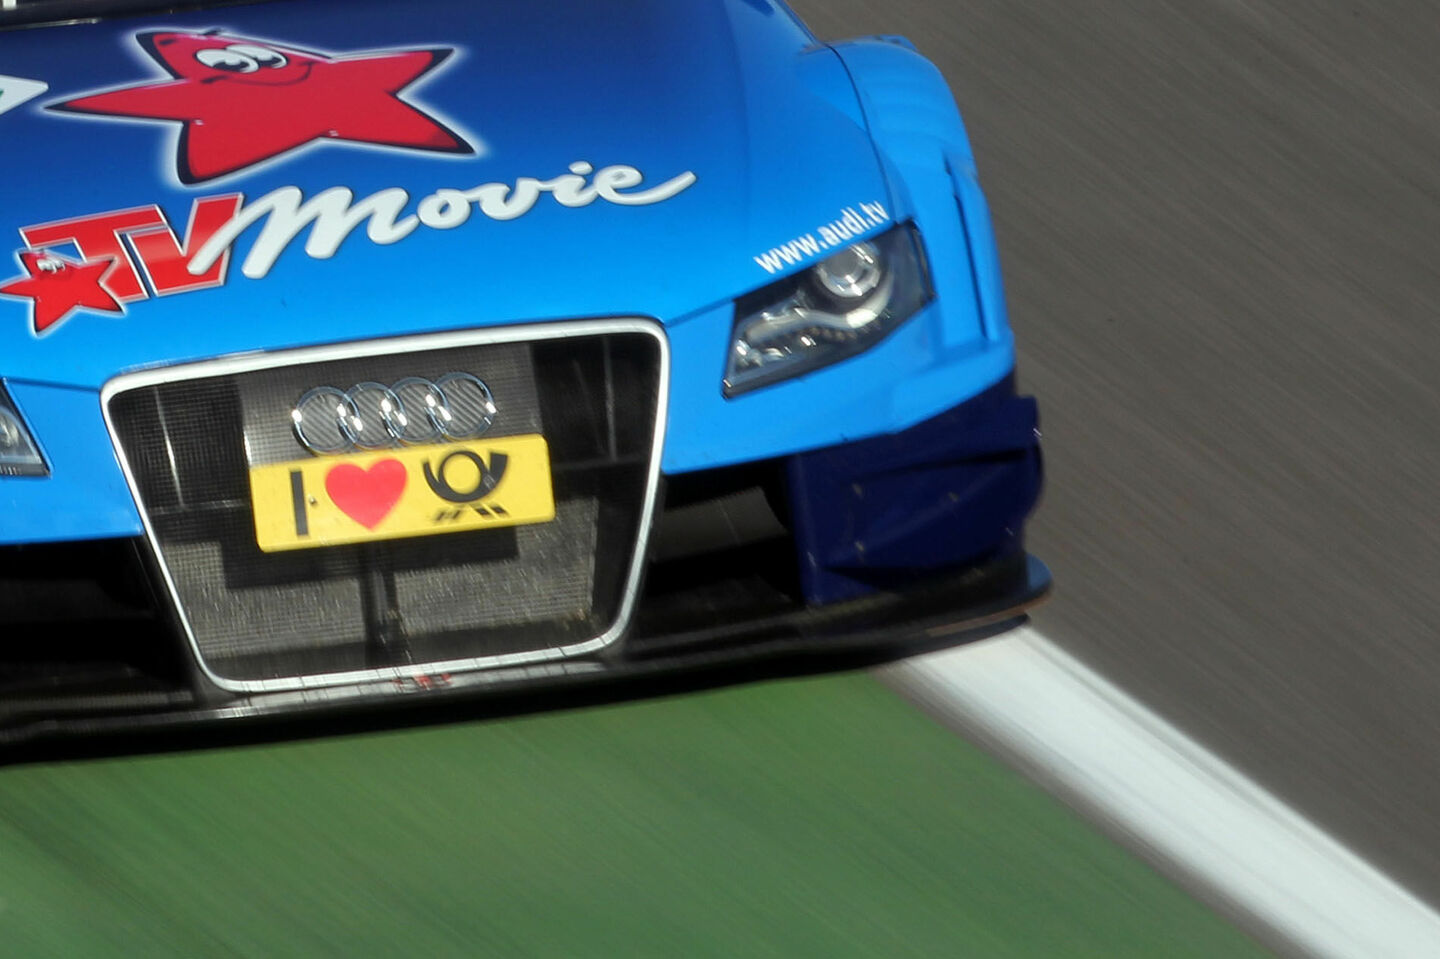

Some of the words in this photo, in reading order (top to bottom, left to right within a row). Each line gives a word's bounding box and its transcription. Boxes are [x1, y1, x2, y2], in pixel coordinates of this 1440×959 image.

[18, 191, 245, 303] TV
[752, 200, 890, 274] www.audi.tv
[289, 468, 310, 537] I
